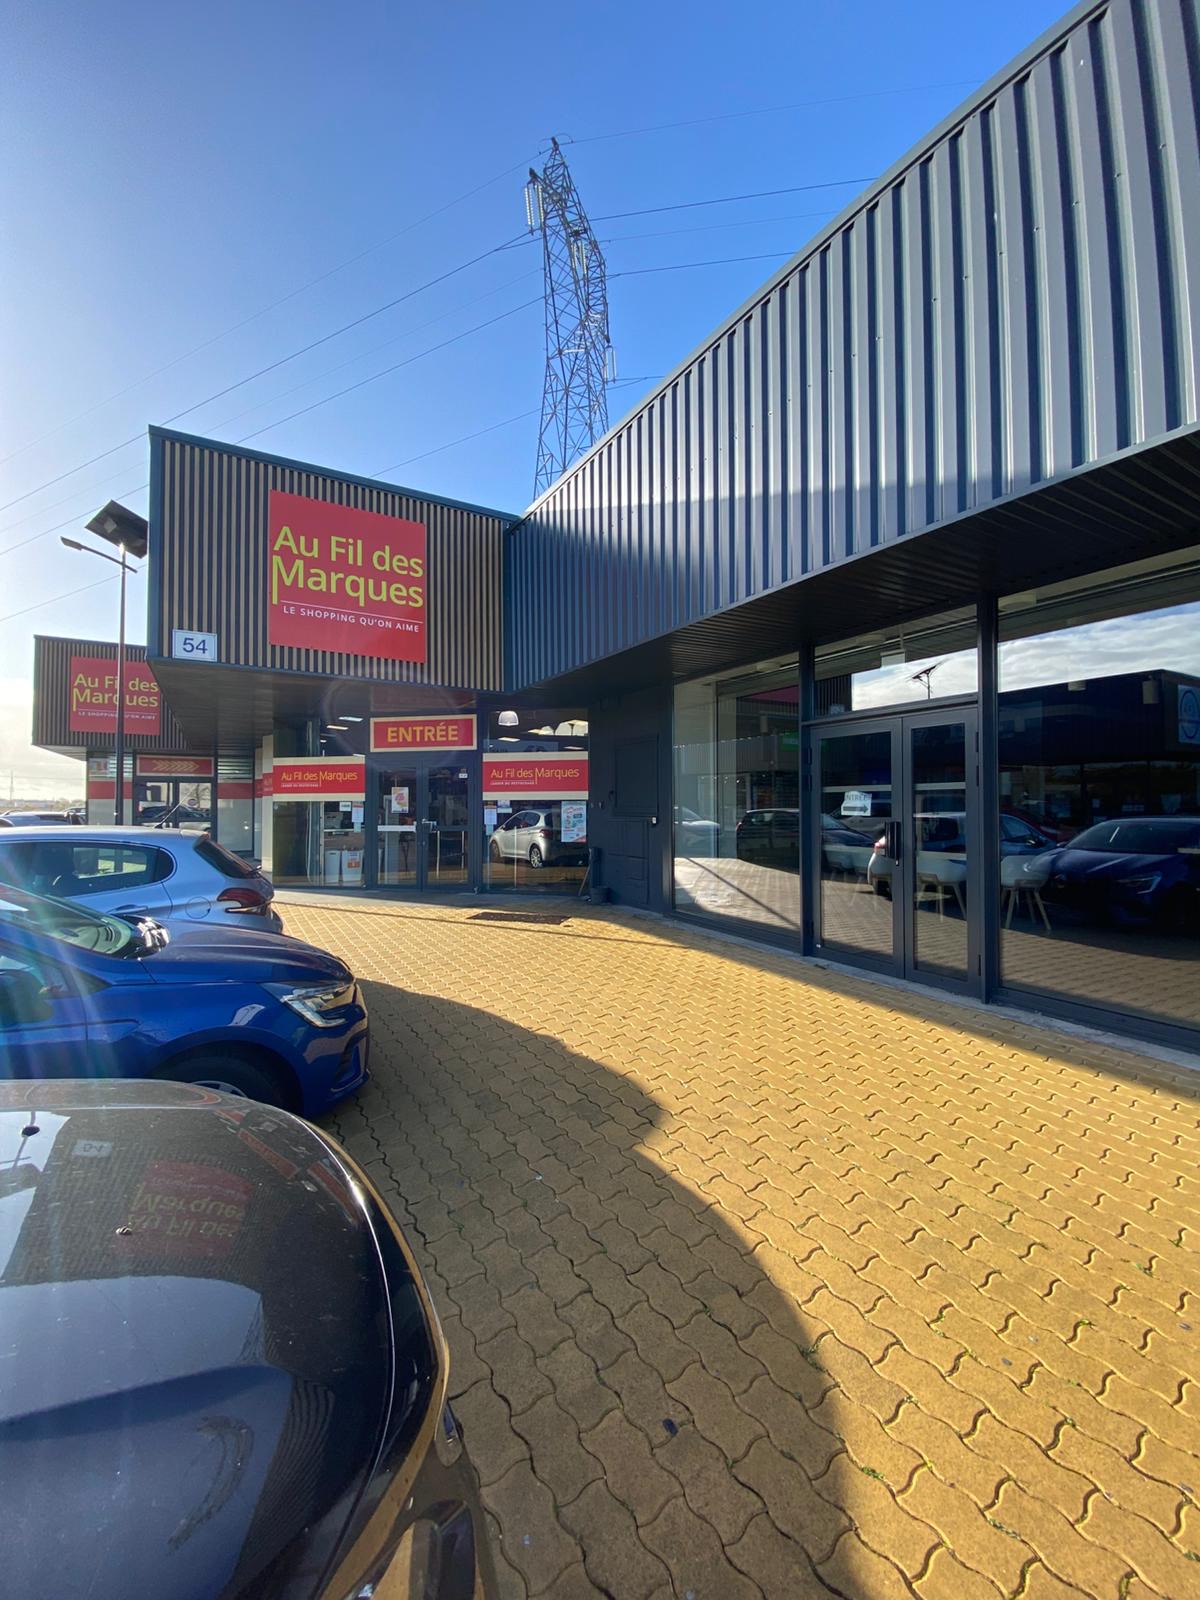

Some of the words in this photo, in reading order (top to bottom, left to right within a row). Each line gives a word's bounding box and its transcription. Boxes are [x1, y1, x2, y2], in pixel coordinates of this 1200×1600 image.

[273, 525, 319, 558] Au
[330, 535, 363, 567] Fil
[372, 544, 424, 578] des
[272, 554, 424, 609] Marques
[283, 606, 296, 615] LE
[299, 607, 356, 624] SHOPPING
[359, 616, 392, 629] QU'ON
[395, 622, 420, 633] AIME
[182, 637, 209, 655] 54
[74, 674, 98, 687] Au
[105, 675, 120, 689] Fi
[128, 678, 158, 692] des
[387, 722, 459, 743] ENTRÉE
[281, 771, 292, 781] Au
[294, 771, 302, 780] Fil
[303, 771, 318, 781] des
[320, 770, 358, 787] Marques
[490, 769, 503, 779] Au
[505, 768, 515, 778] Fil
[516, 768, 533, 778] des
[535, 767, 580, 785] Marques
